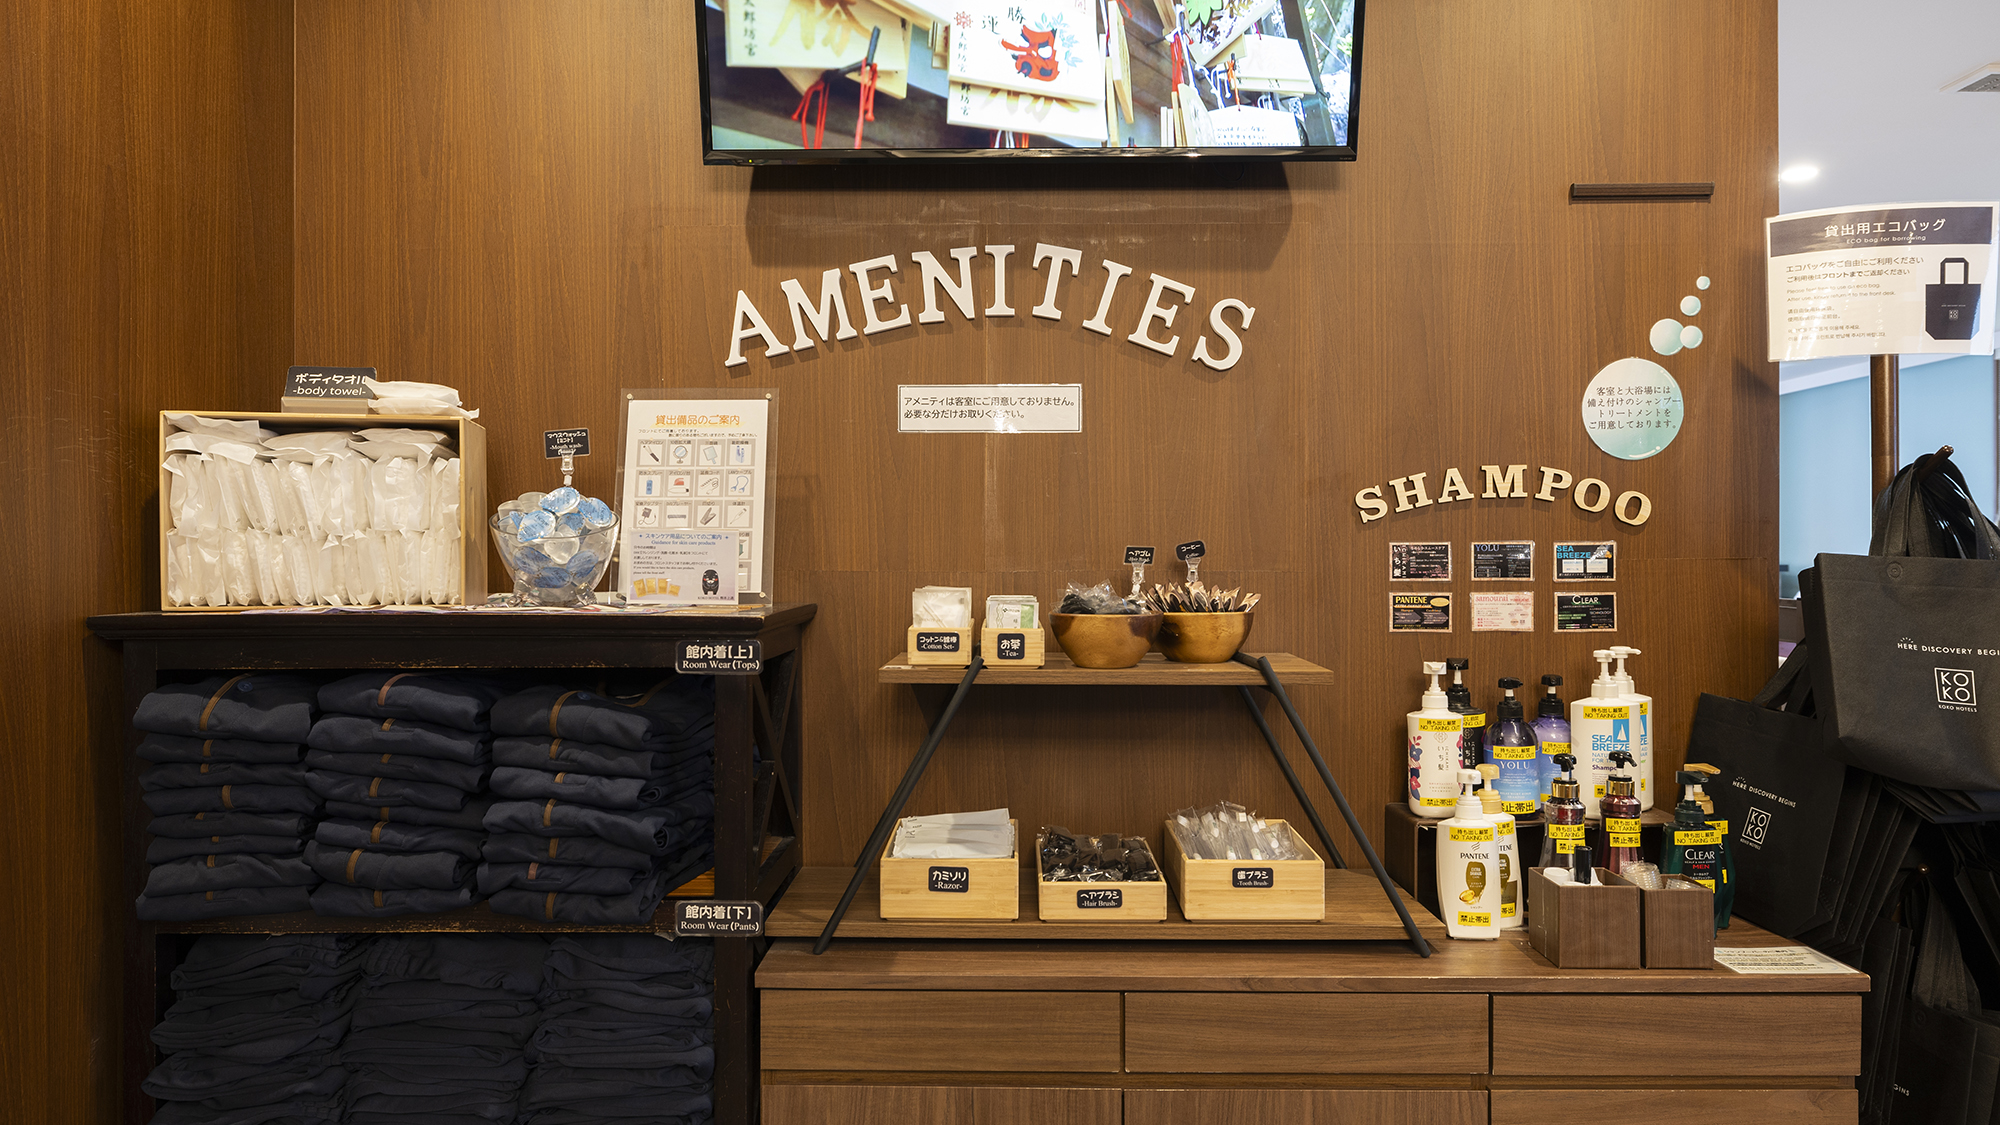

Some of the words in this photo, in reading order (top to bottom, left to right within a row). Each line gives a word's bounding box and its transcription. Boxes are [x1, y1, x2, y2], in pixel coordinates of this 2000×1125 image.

[1824, 217, 1947, 239] 貸出用エコバッグ
[1864, 236, 1879, 244] bag
[1892, 234, 1927, 243] borrowing
[1786, 256, 1925, 274] エコバッグをご自由にご利用ください
[1786, 267, 1911, 284] ご利用後はフロントまでご返却ください
[725, 242, 1256, 372] AMENITIES
[292, 385, 328, 397] -body
[330, 387, 367, 396] towel-
[1596, 386, 1671, 396] 客室と大浴場には
[903, 396, 1075, 407] アメニティは客室にご用意しておりません。
[903, 409, 1025, 419] 必要な分だけお取りください。
[1599, 409, 1671, 418] トリートメントを
[656, 414, 740, 426] 貸出備品のご案内
[1588, 420, 1678, 430] ご用意しております。
[1355, 464, 1653, 527] SHAMPOO
[1474, 544, 1500, 552] YOLU
[1395, 596, 1428, 604] PANTENE
[1572, 594, 1599, 604] CLEAR
[1000, 639, 1021, 650] お茶
[1897, 642, 1918, 651] HERE
[1921, 644, 1973, 655] DISCOVERY
[685, 644, 754, 660] 館内着【上】
[682, 660, 707, 669] Room
[709, 660, 731, 669] Wear
[732, 660, 760, 671] (Tops)
[1940, 671, 1969, 687] KO
[1942, 686, 1971, 702] KO
[1592, 734, 1613, 743] SEA
[1592, 743, 1630, 752] BREEZE
[1500, 761, 1530, 769] YOLU
[1748, 786, 1778, 801] DISCOVERY
[1685, 848, 1715, 860] CLEAR
[932, 870, 967, 881] カミソリ
[1237, 870, 1269, 880] 歯ブラシ
[934, 881, 963, 890] -Razor-
[1080, 891, 1120, 900] ヘアブラシ
[685, 904, 752, 920] 館内着【下】
[681, 920, 706, 930] Room
[707, 920, 730, 930] Wear
[730, 921, 759, 932] (Pants)
